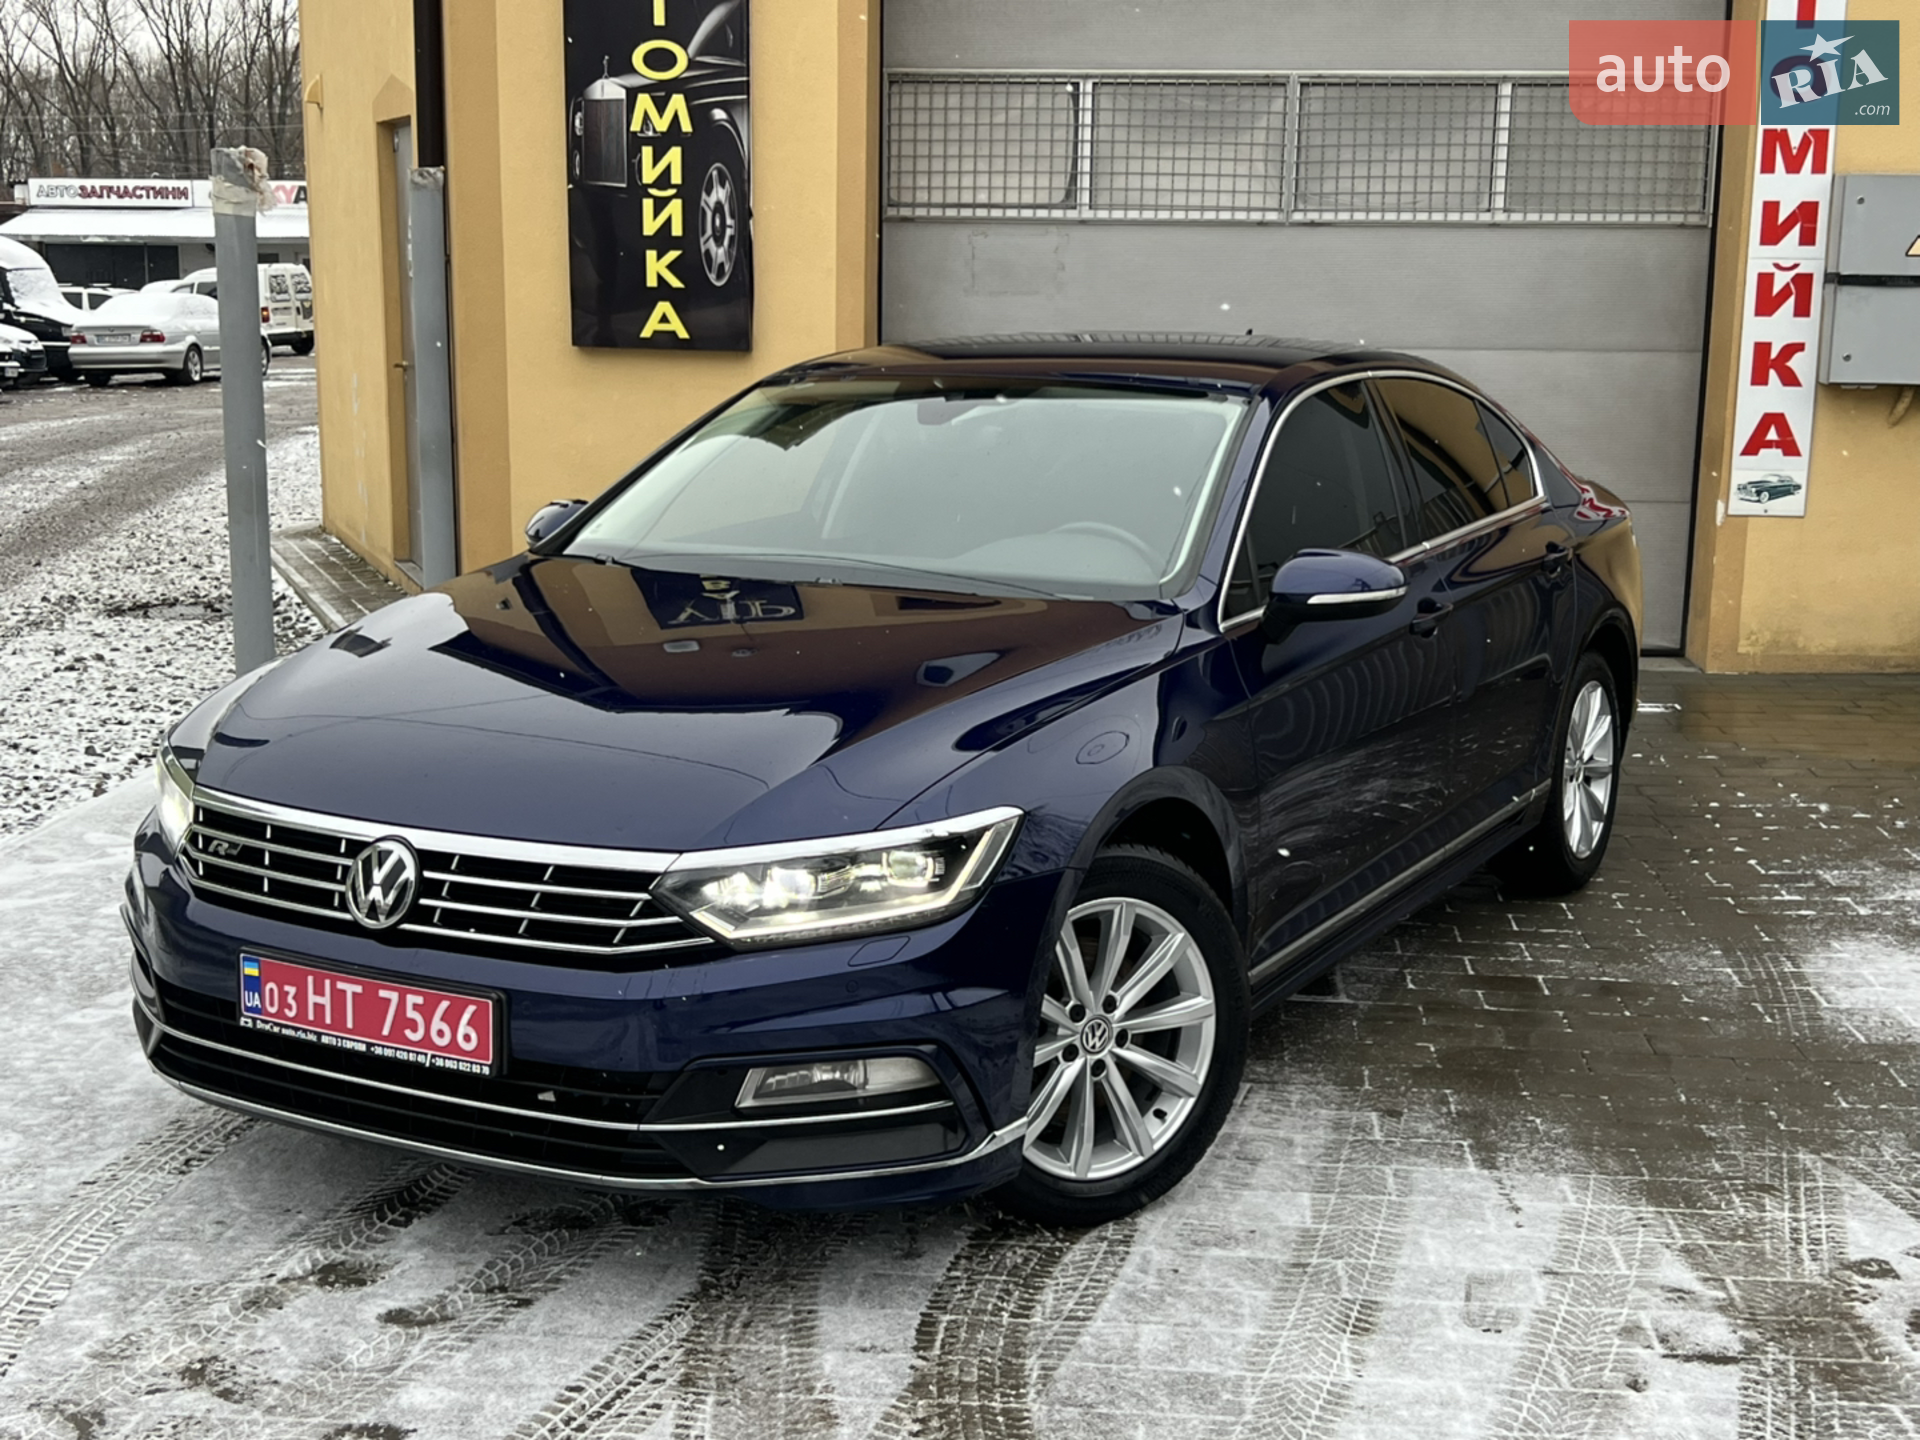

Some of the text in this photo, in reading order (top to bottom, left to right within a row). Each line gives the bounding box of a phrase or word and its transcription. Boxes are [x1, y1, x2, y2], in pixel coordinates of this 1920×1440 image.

[37, 184, 189, 200] АВТОЗАПЧАСТИНИ
[244, 990, 262, 1009] UA
[378, 989, 479, 1052] 7566
